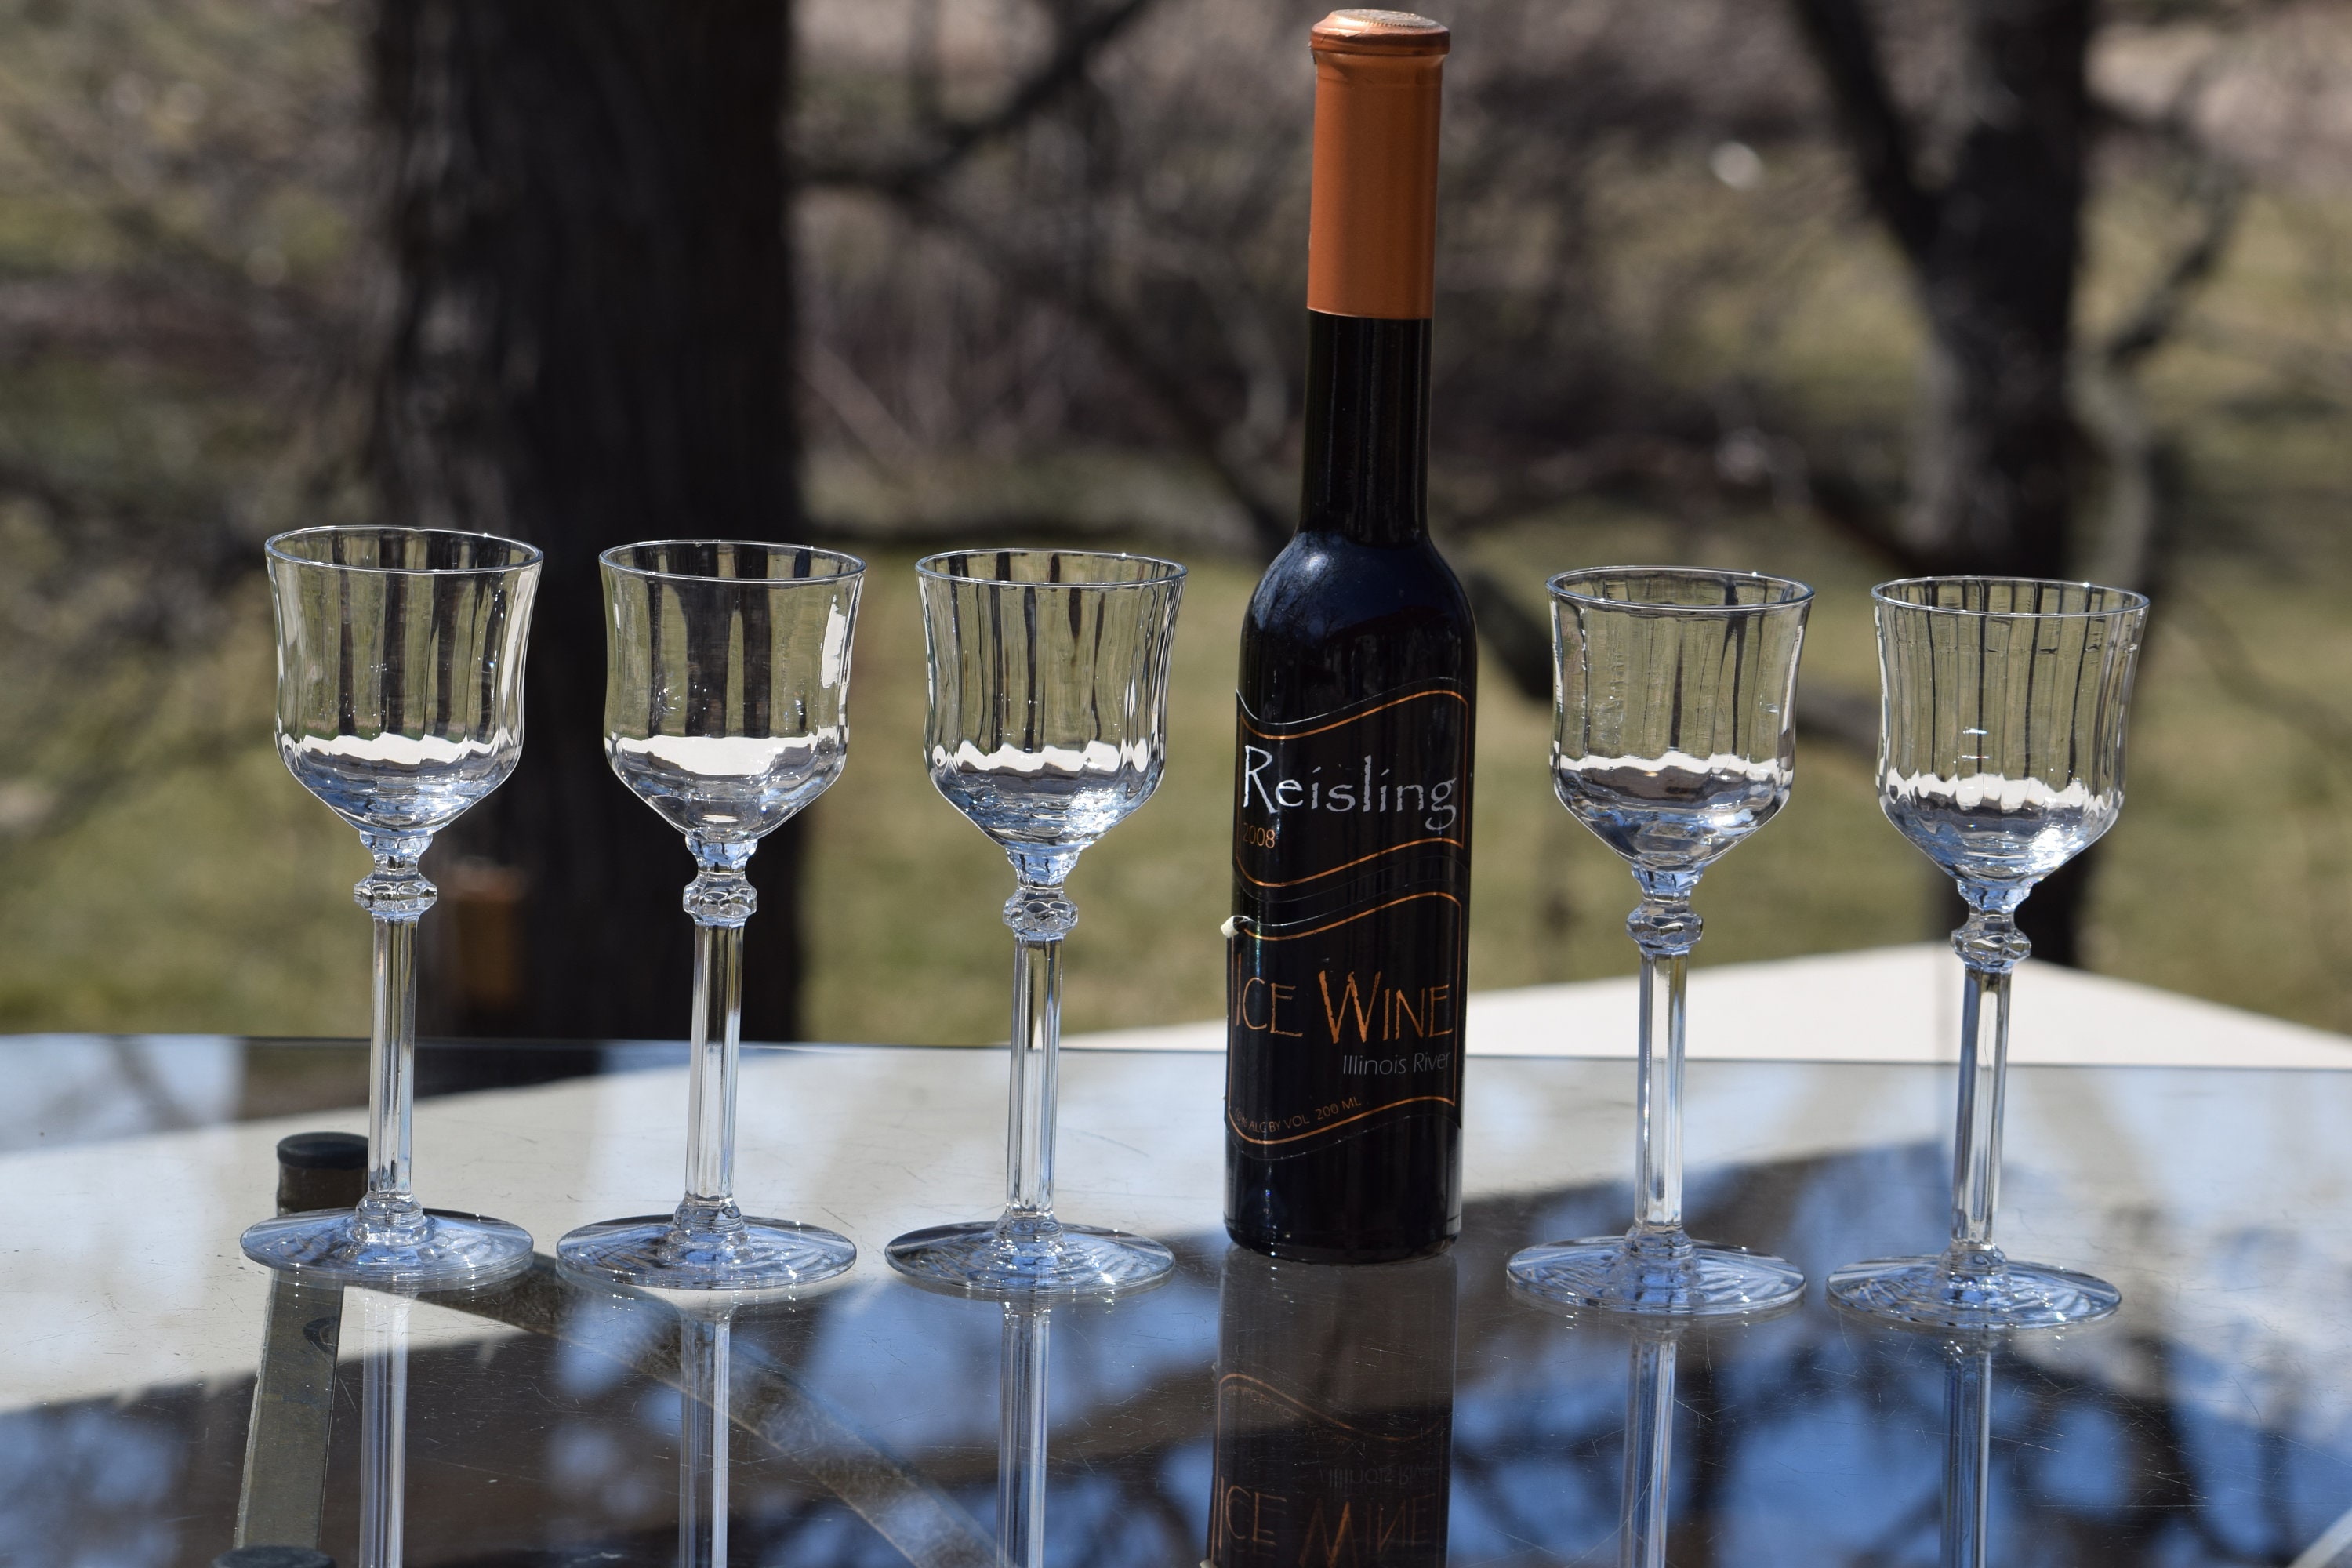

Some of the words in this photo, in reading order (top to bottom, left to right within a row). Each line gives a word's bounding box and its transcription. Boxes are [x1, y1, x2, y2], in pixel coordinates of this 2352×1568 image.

[1243, 744, 1457, 832] Reisling
[1242, 822, 1276, 849] 2008
[1235, 952, 1303, 1038] ICE
[1318, 969, 1454, 1044] WINE
[1342, 1054, 1407, 1075] Illinois
[1413, 1051, 1451, 1073] River
[1269, 1120, 1281, 1133] BY
[1283, 1114, 1311, 1130] VOL
[1315, 1103, 1340, 1120] 200
[1341, 1096, 1362, 1111] ML
